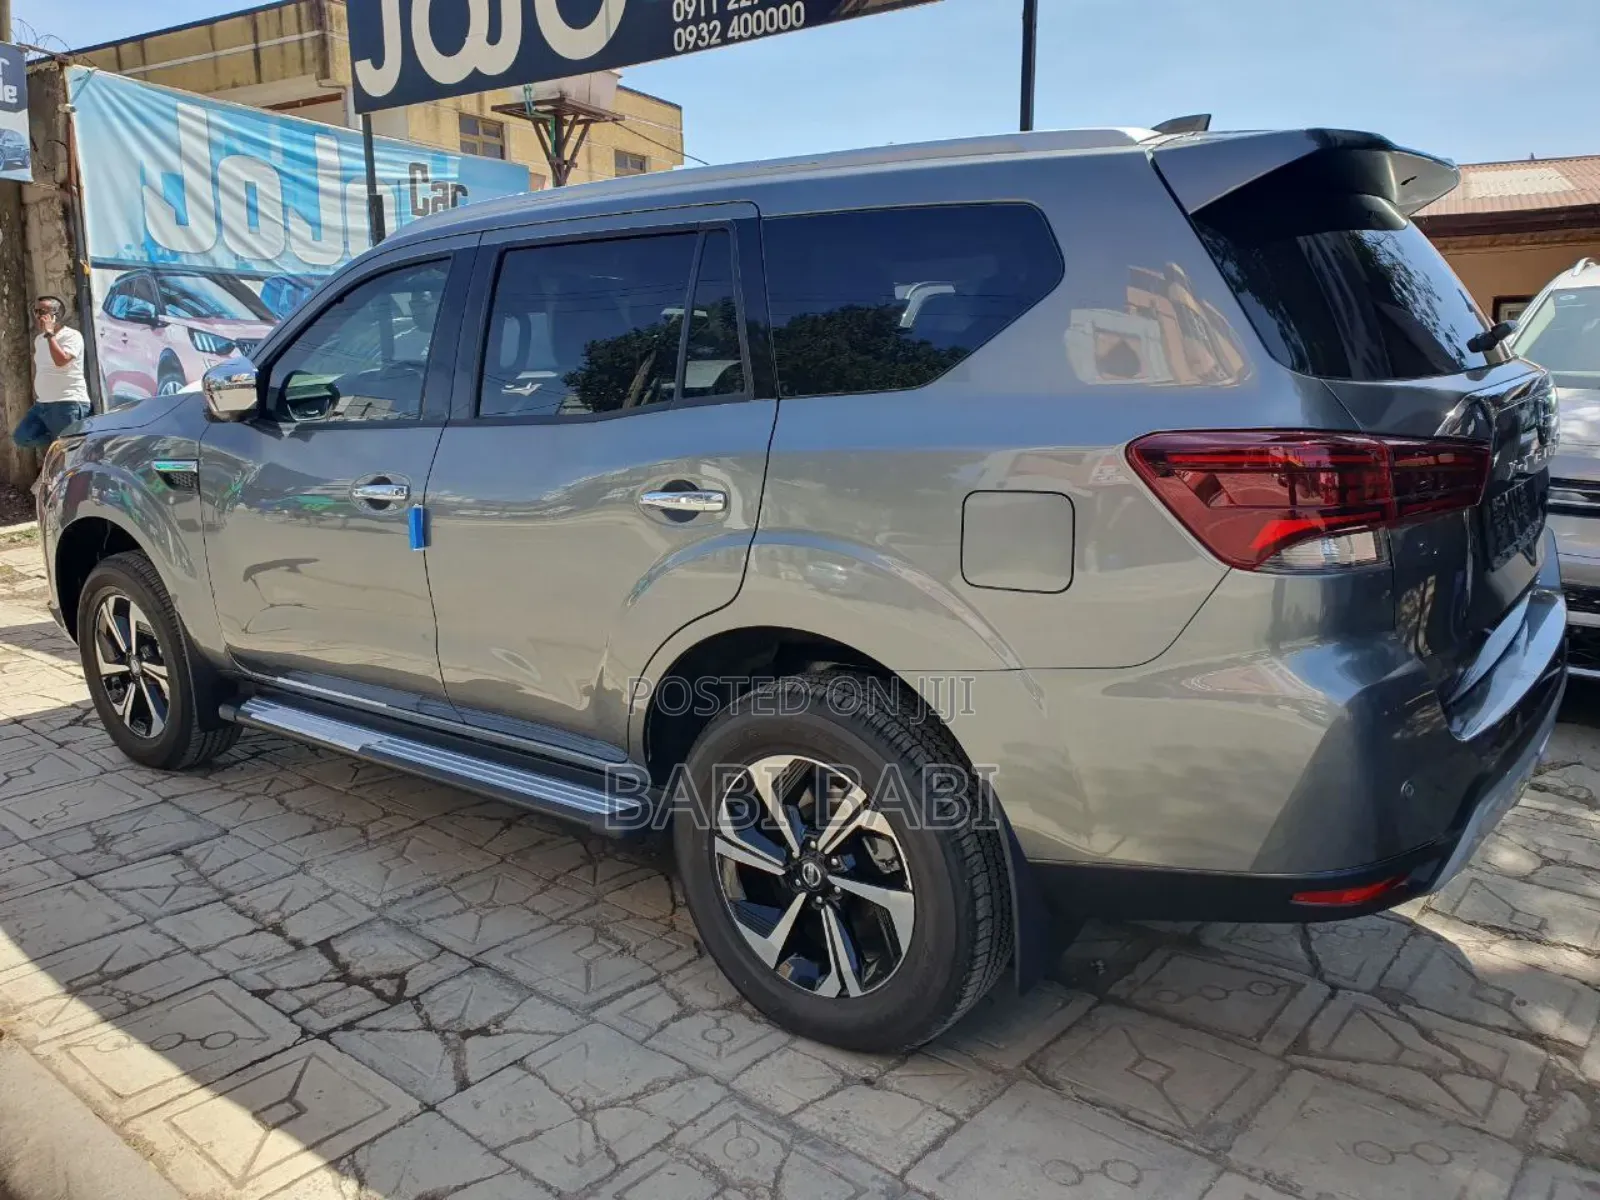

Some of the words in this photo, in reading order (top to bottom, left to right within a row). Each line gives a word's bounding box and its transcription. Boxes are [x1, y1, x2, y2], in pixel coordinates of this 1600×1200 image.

[673, 20, 721, 52] 0932
[727, 1, 805, 39] 400000
[408, 161, 469, 217] Car
